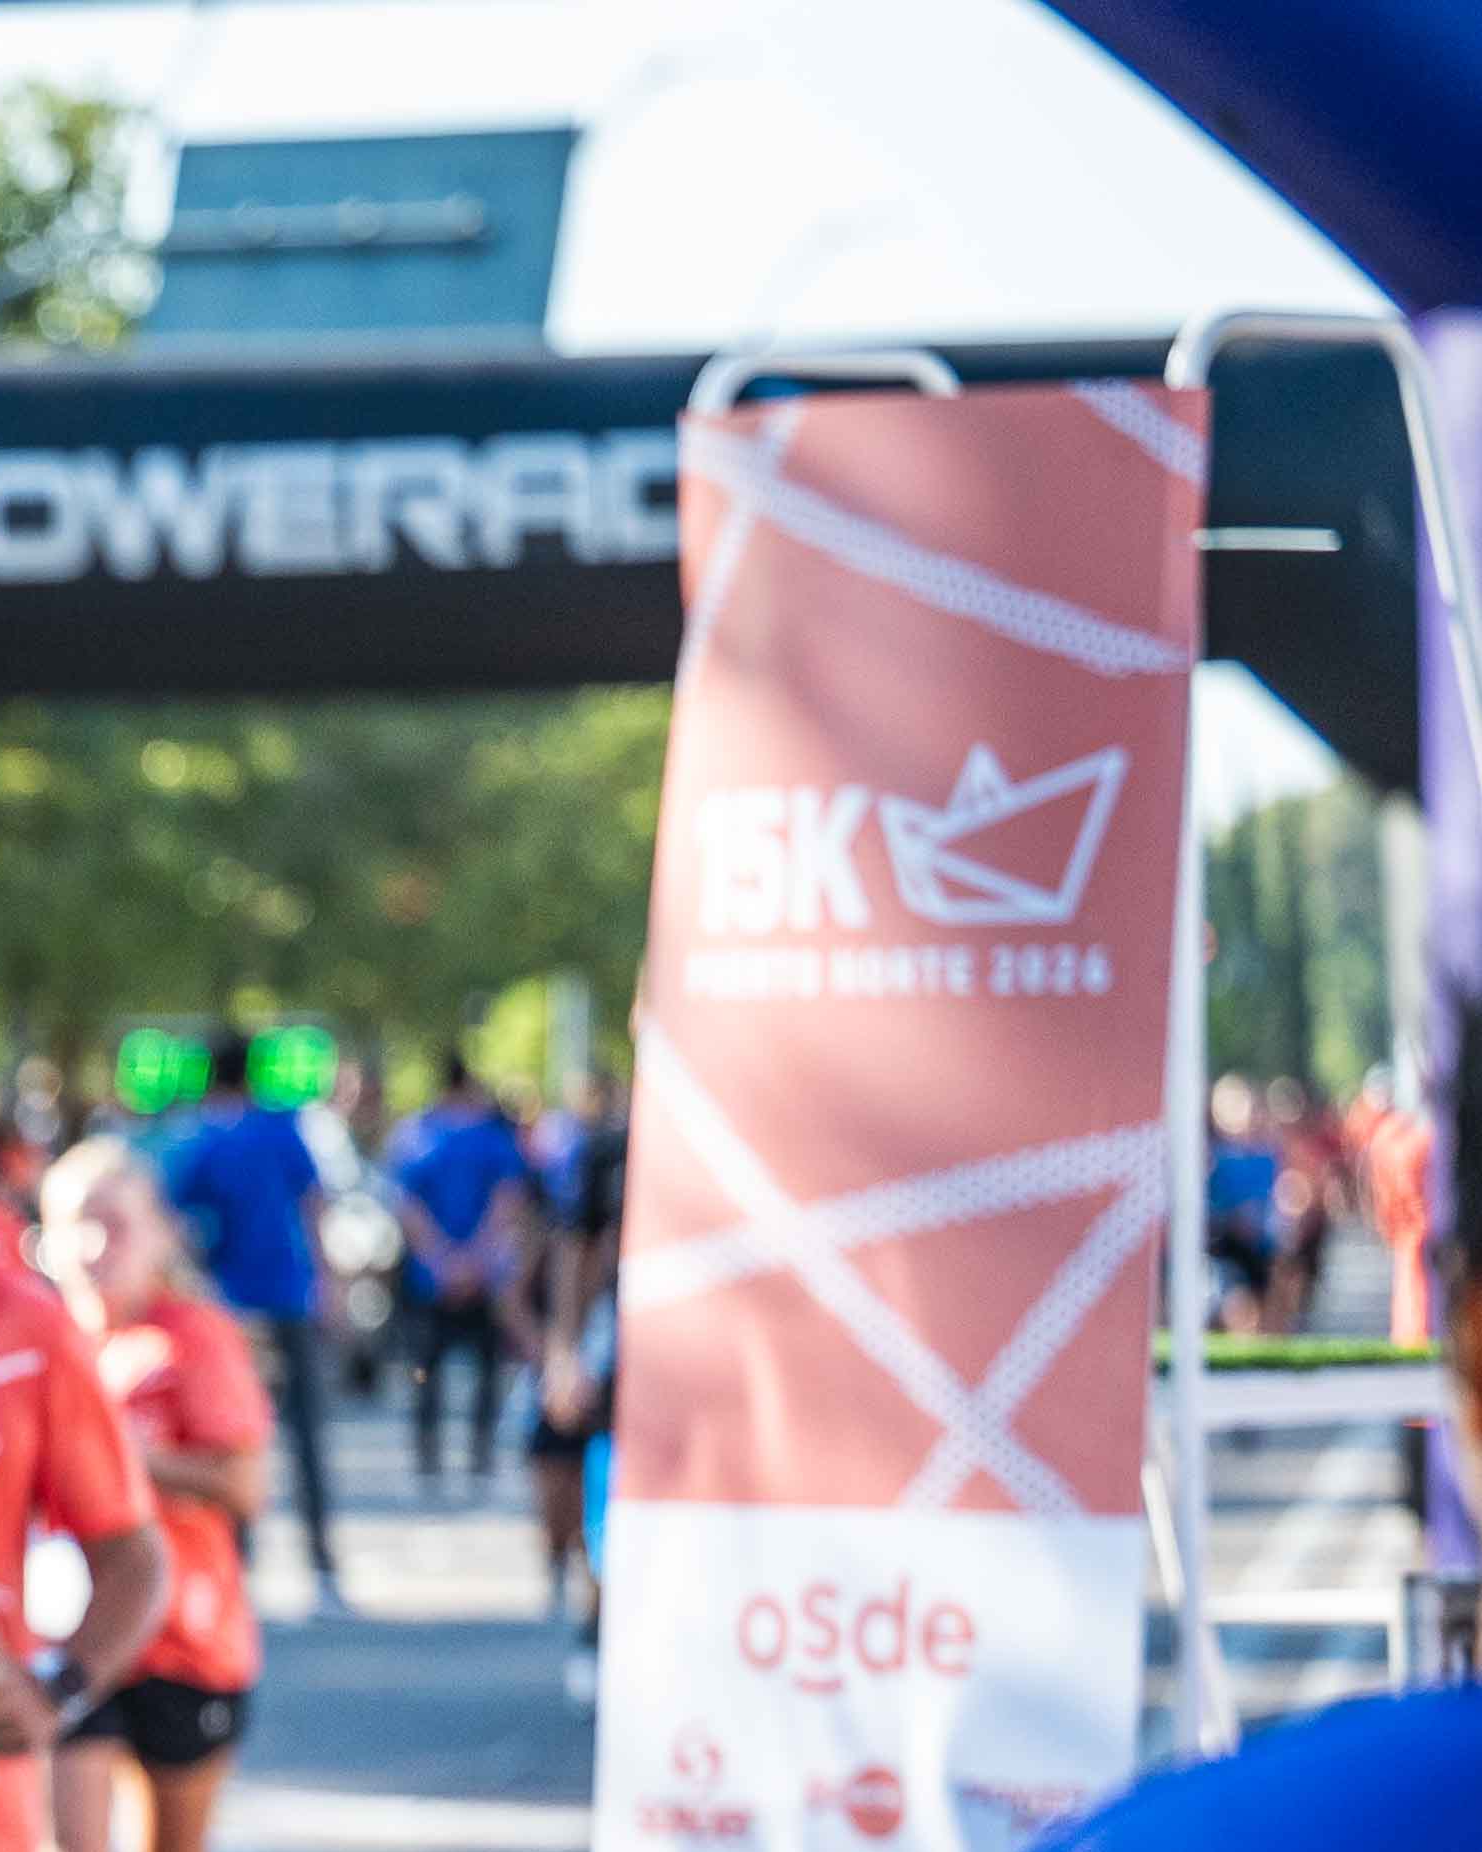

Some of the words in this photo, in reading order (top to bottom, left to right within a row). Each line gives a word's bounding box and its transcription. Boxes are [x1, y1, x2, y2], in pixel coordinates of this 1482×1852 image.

[698, 783, 873, 936] 15K
[831, 944, 975, 997] NORTE
[737, 1572, 975, 1680] osde
